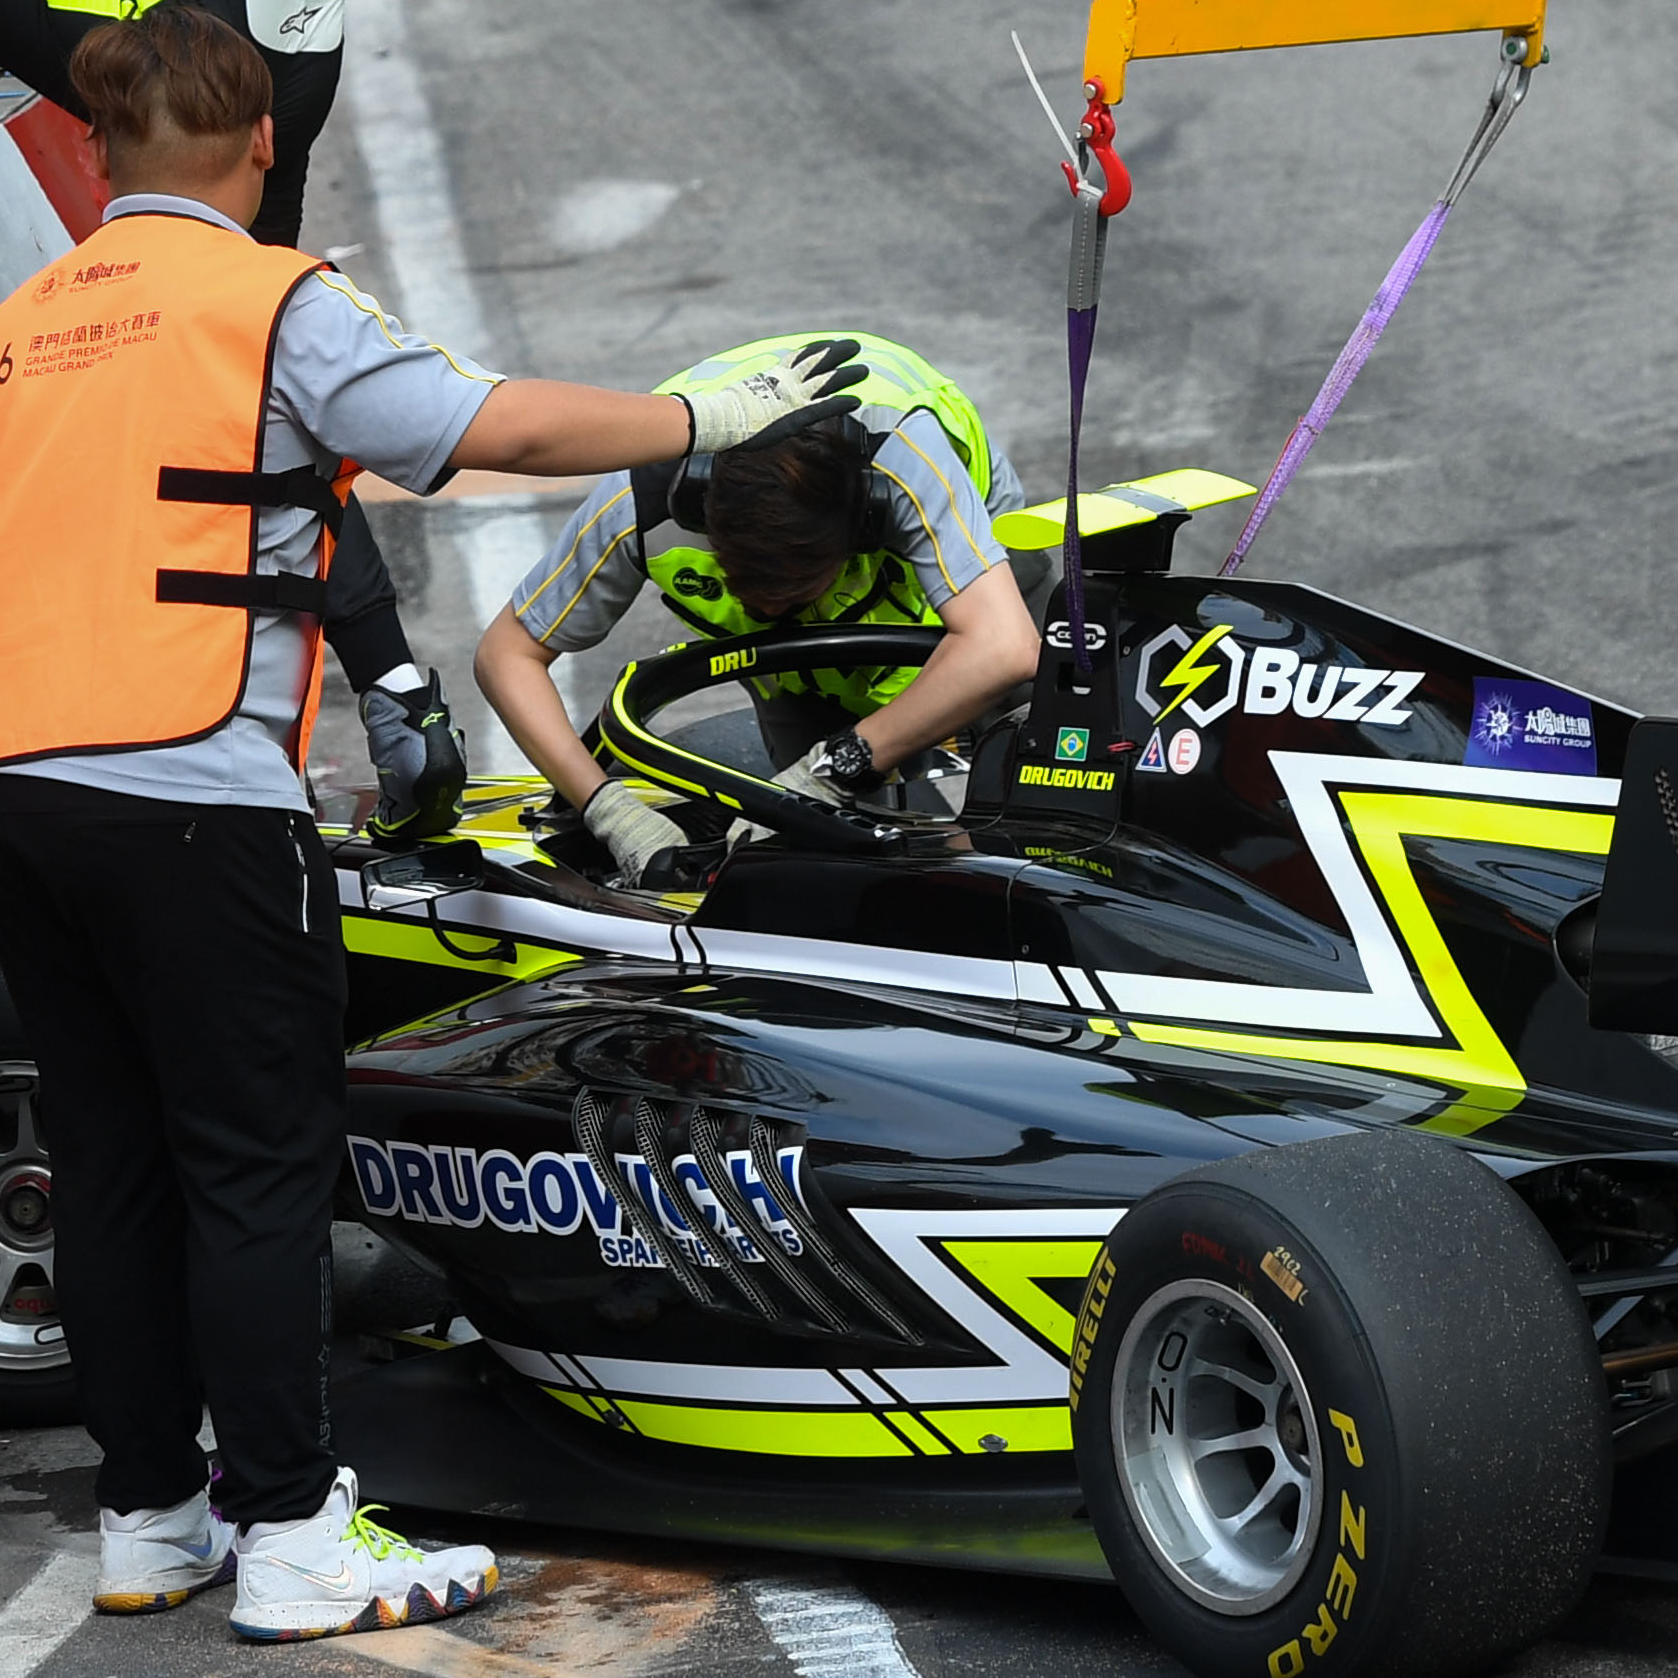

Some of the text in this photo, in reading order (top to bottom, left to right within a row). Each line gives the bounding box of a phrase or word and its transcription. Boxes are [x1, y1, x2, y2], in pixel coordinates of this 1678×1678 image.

[25, 348, 67, 367] GRANDE
[121, 331, 158, 347] MACAU
[22, 363, 57, 379] MACAU
[57, 357, 96, 373] GRAND
[1175, 737, 1193, 766] E
[1523, 733, 1592, 749] SUNCITY GROUP
[1018, 764, 1116, 791] DRUGOVICH
[1266, 1407, 1367, 1678] P ZERO
